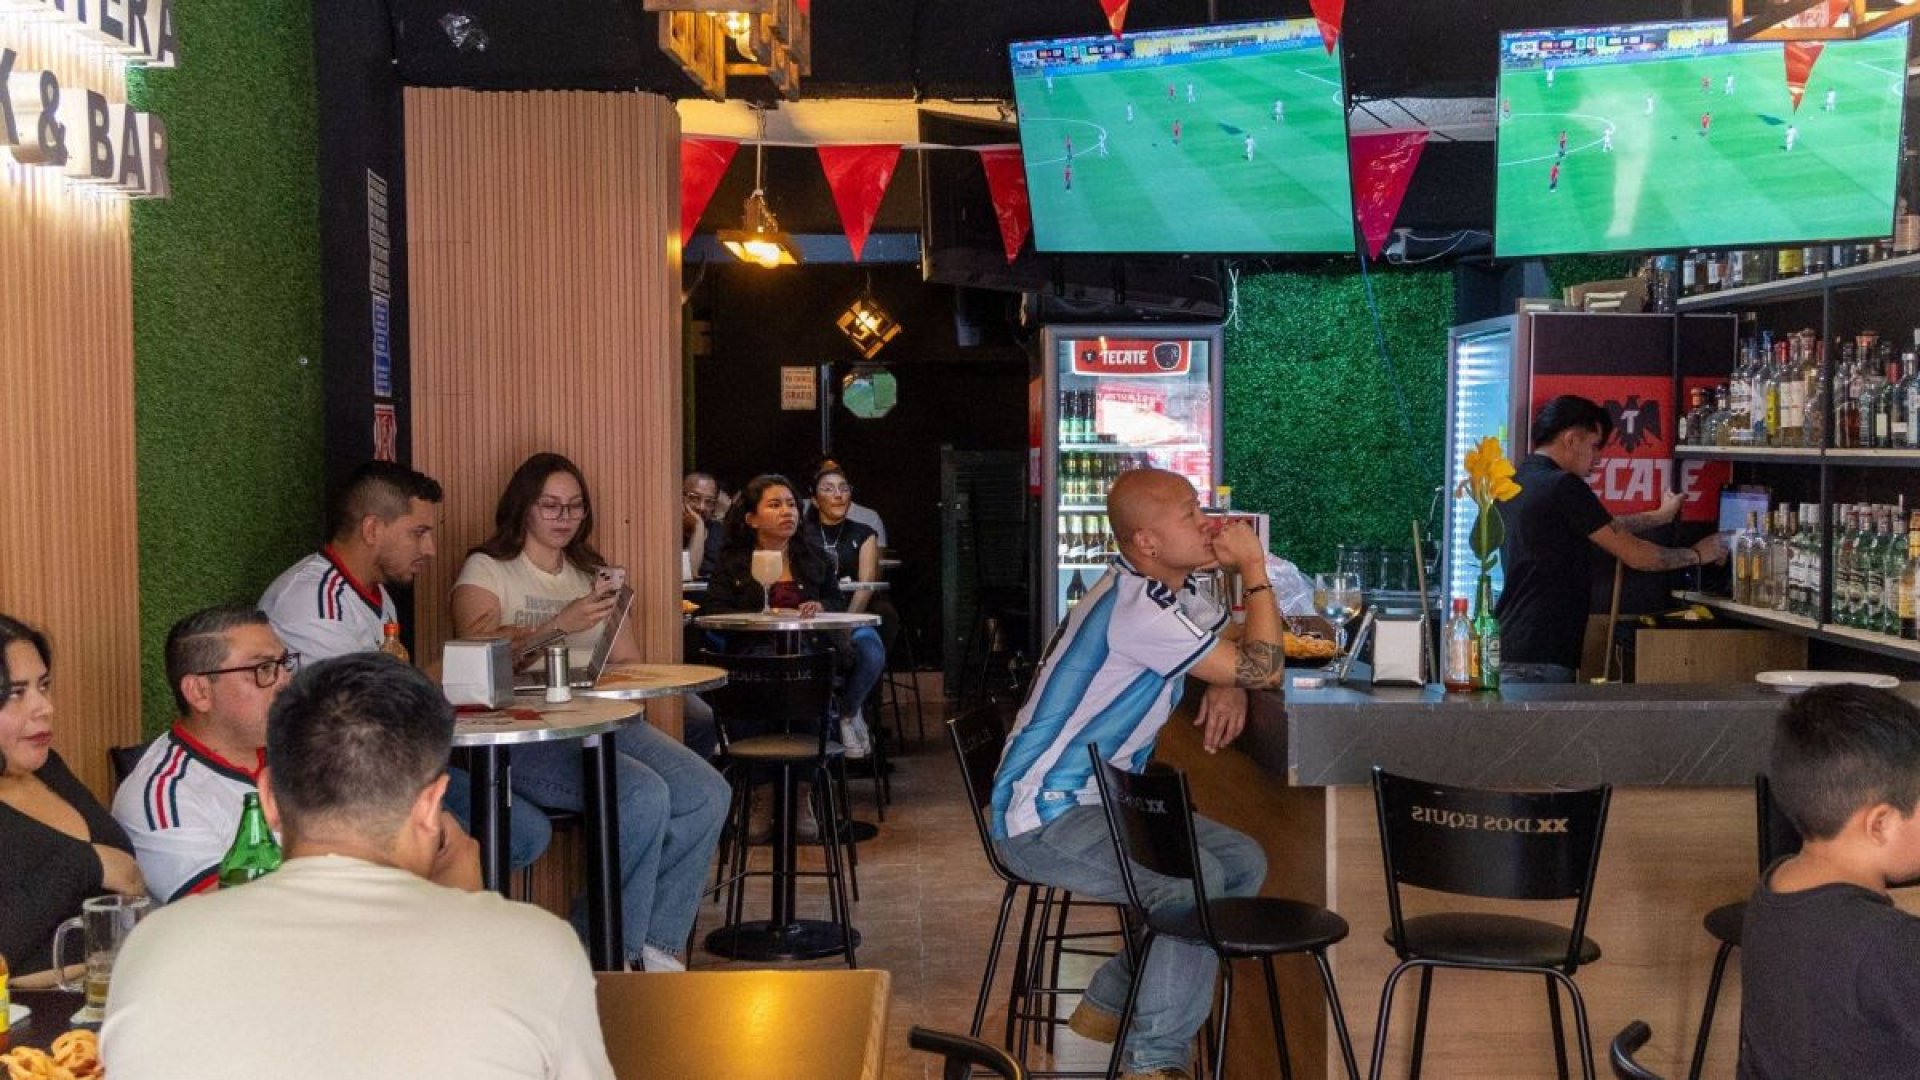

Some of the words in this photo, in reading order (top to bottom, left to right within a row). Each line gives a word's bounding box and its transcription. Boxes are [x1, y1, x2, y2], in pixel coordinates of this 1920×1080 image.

[86, 89, 171, 198] BAR
[1098, 349, 1149, 366] TECATE
[1620, 410, 1641, 434] T
[1583, 457, 1705, 501] ECATE
